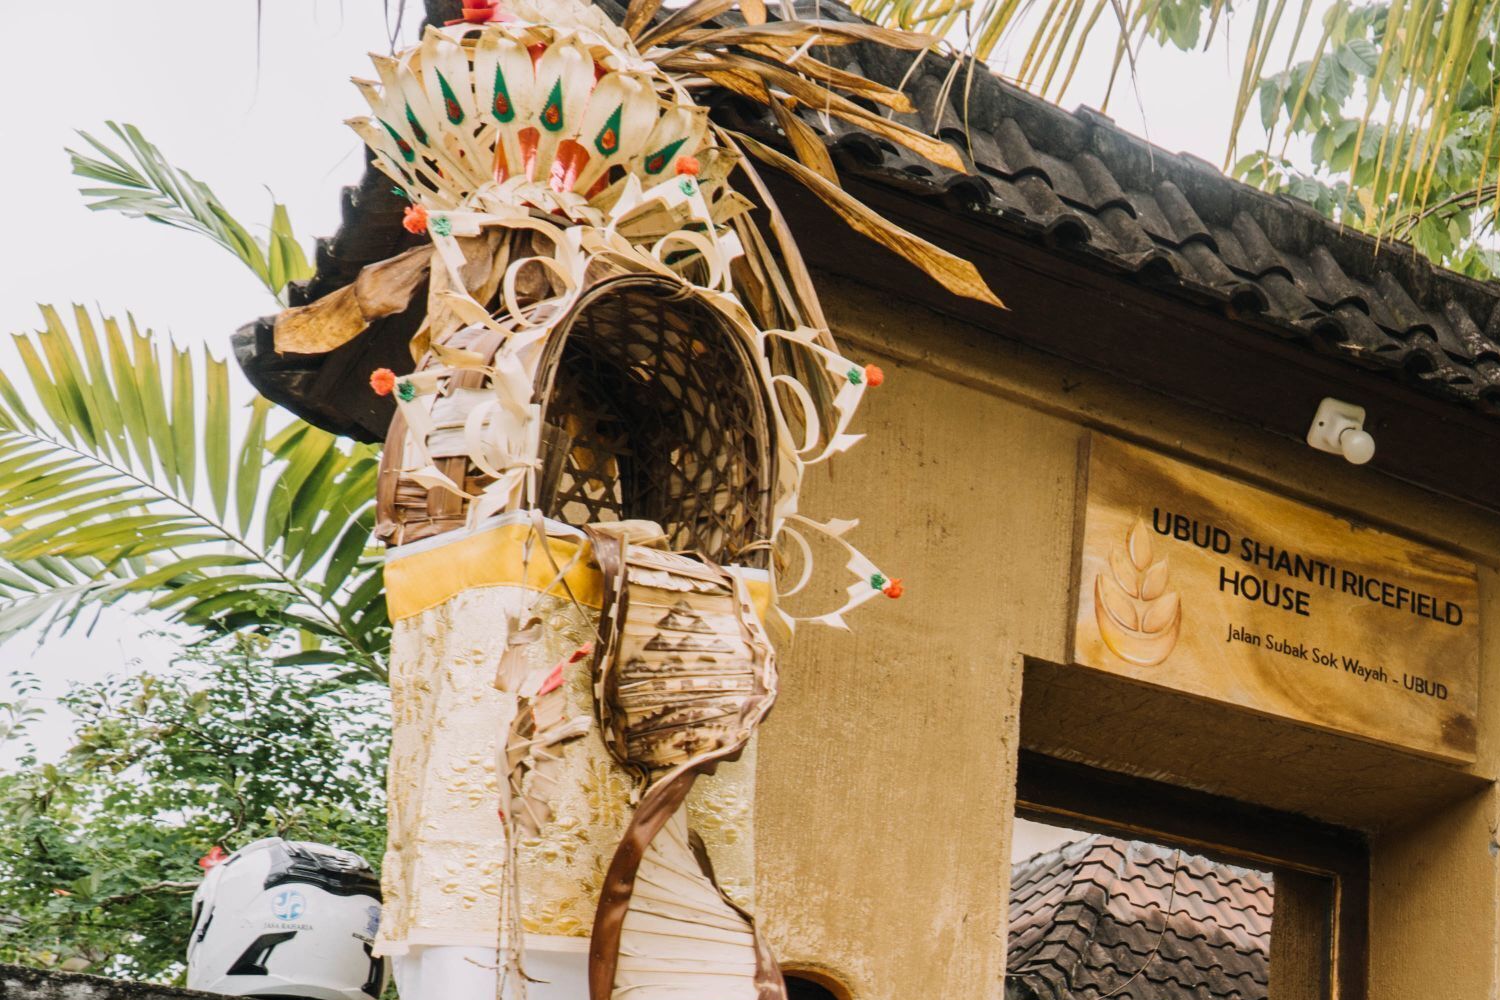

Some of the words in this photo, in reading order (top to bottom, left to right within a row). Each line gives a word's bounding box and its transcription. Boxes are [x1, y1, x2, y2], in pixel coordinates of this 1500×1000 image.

[1153, 507, 1231, 555] UBUD
[1240, 537, 1336, 589] SHANTI
[1341, 571, 1463, 627] RICEFIELD
[1219, 566, 1311, 617] HOUSE
[1227, 623, 1261, 647] Jalan
[1265, 635, 1308, 661] Subak
[1312, 648, 1338, 669] Sok
[1341, 656, 1388, 685] Wayah
[1403, 674, 1448, 700] UBUD
